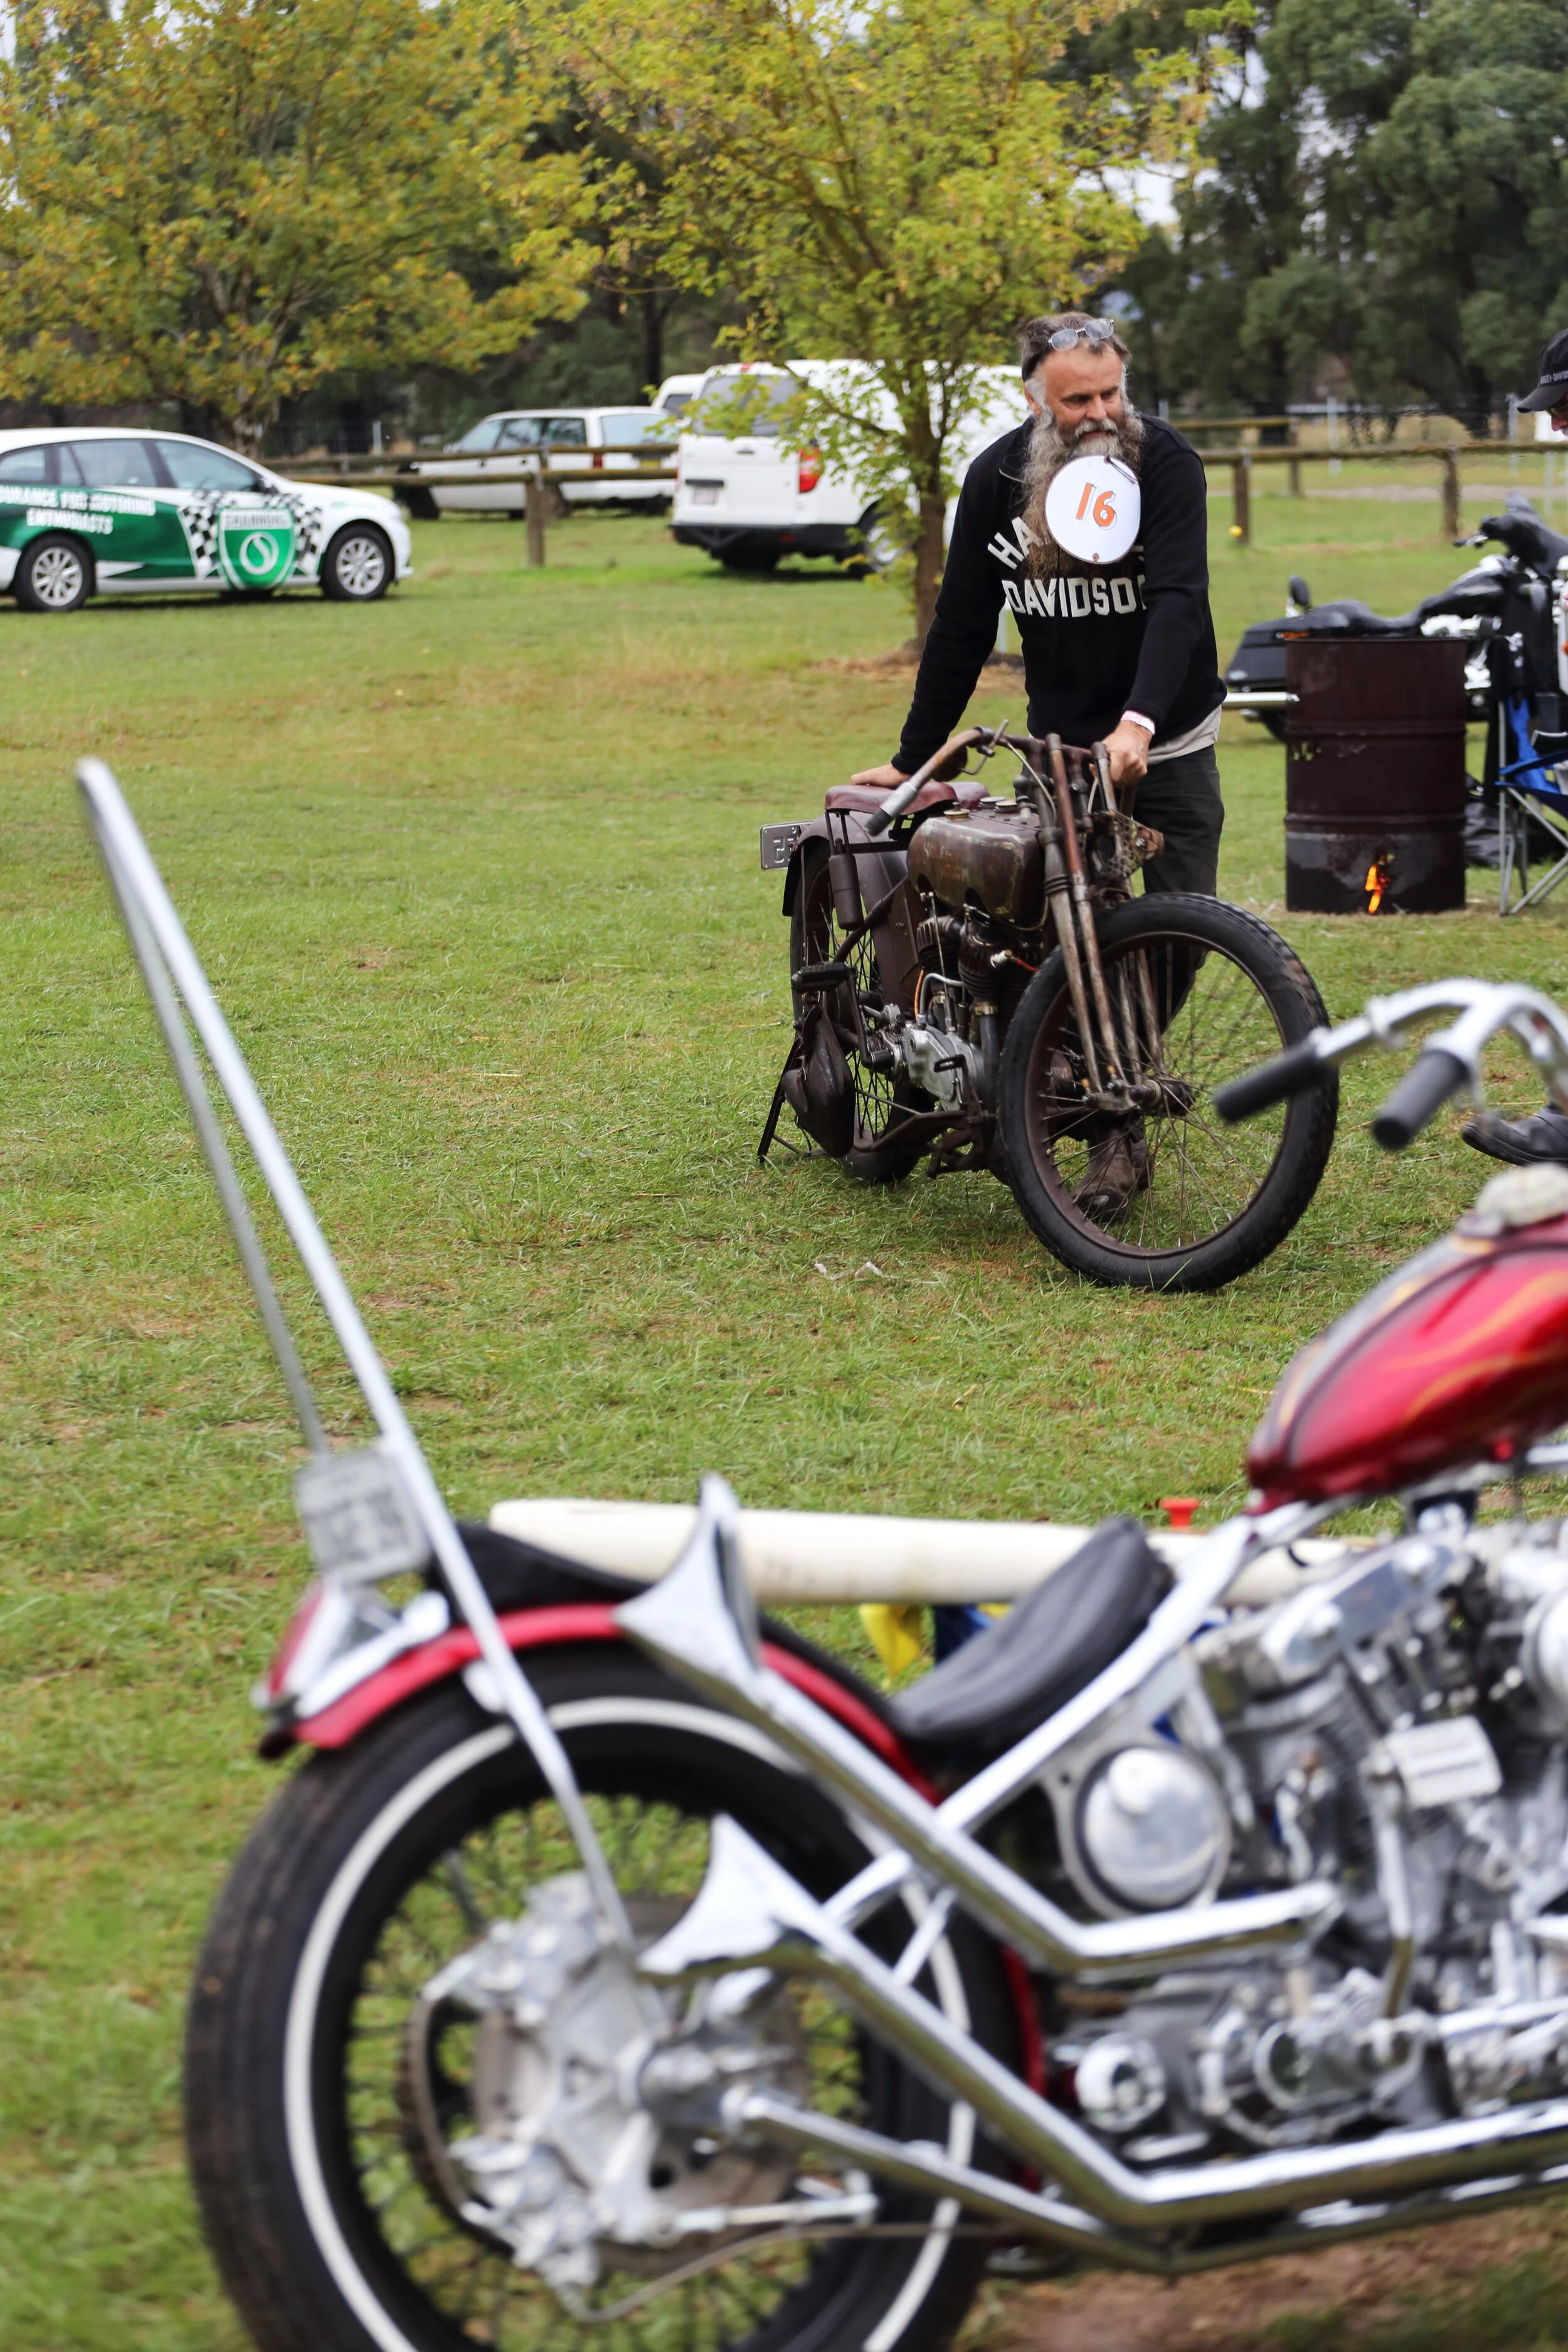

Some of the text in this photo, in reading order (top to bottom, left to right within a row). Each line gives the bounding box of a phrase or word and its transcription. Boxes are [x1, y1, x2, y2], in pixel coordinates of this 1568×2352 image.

[60, 491, 88, 509] FOR
[1076, 482, 1117, 530] 16
[26, 507, 114, 535] ENTHUSIASTS
